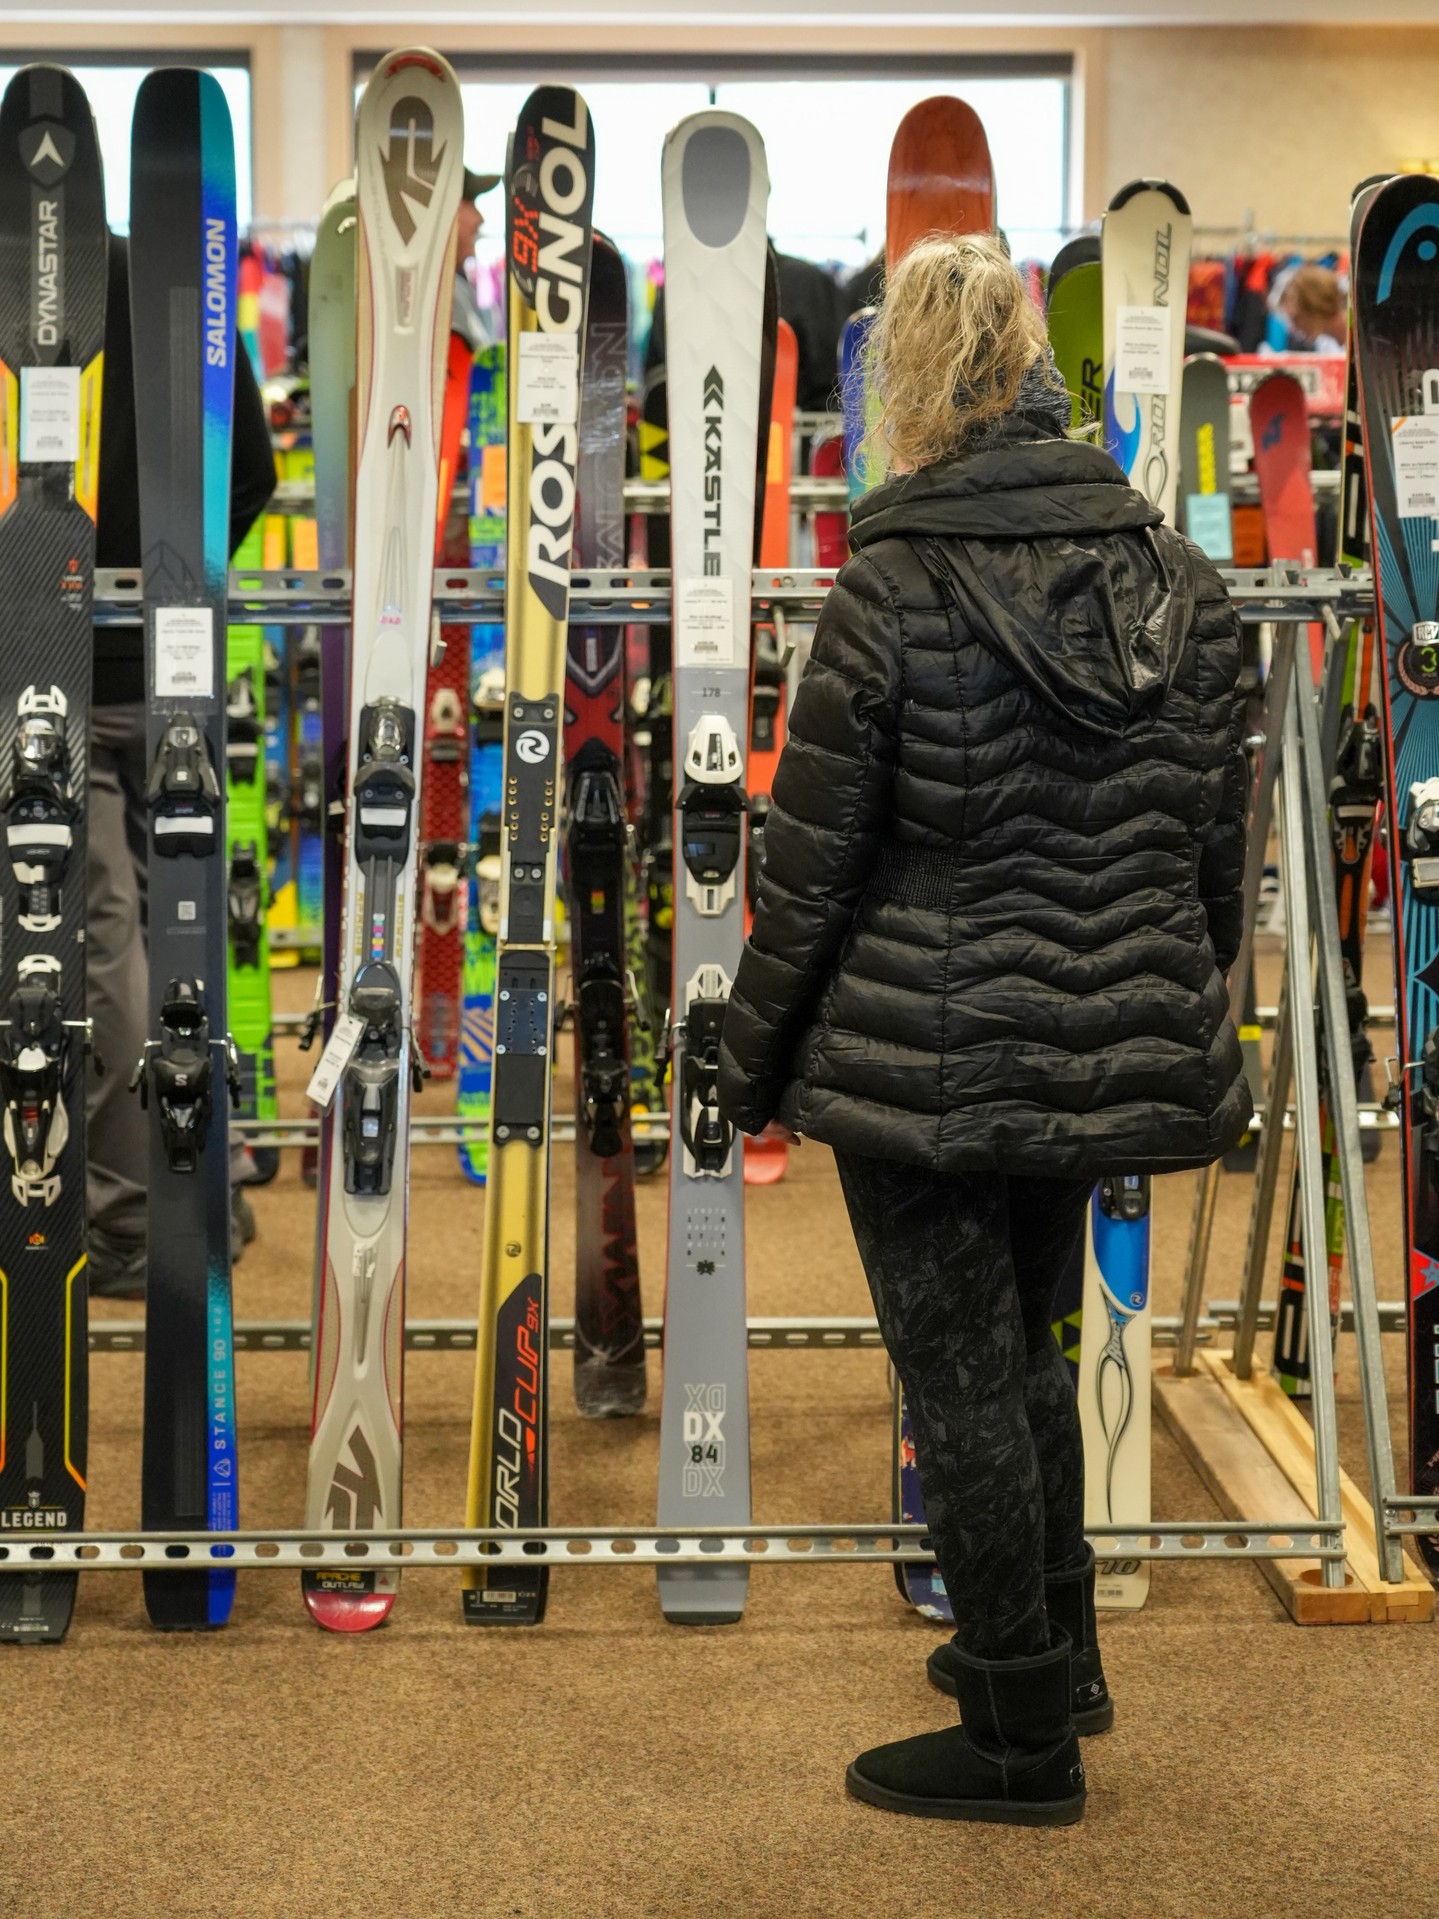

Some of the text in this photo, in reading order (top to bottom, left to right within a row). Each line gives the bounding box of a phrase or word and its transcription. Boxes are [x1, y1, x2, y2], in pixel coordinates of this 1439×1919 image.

[37, 200, 58, 346] DYNASTAR
[206, 218, 228, 368] SALOMON
[528, 91, 587, 587] ROSGNOL
[702, 688, 721, 698] 178
[214, 1338, 226, 1361] 90
[214, 1370, 226, 1450] STANCE
[495, 1408, 521, 1529] ORLD
[514, 1325, 539, 1425] CUP
[684, 1412, 725, 1441] DX
[692, 1444, 718, 1463] 84
[683, 1467, 724, 1496] DX
[1, 1511, 67, 1527] LEGEND
[316, 1572, 361, 1581] APACHE
